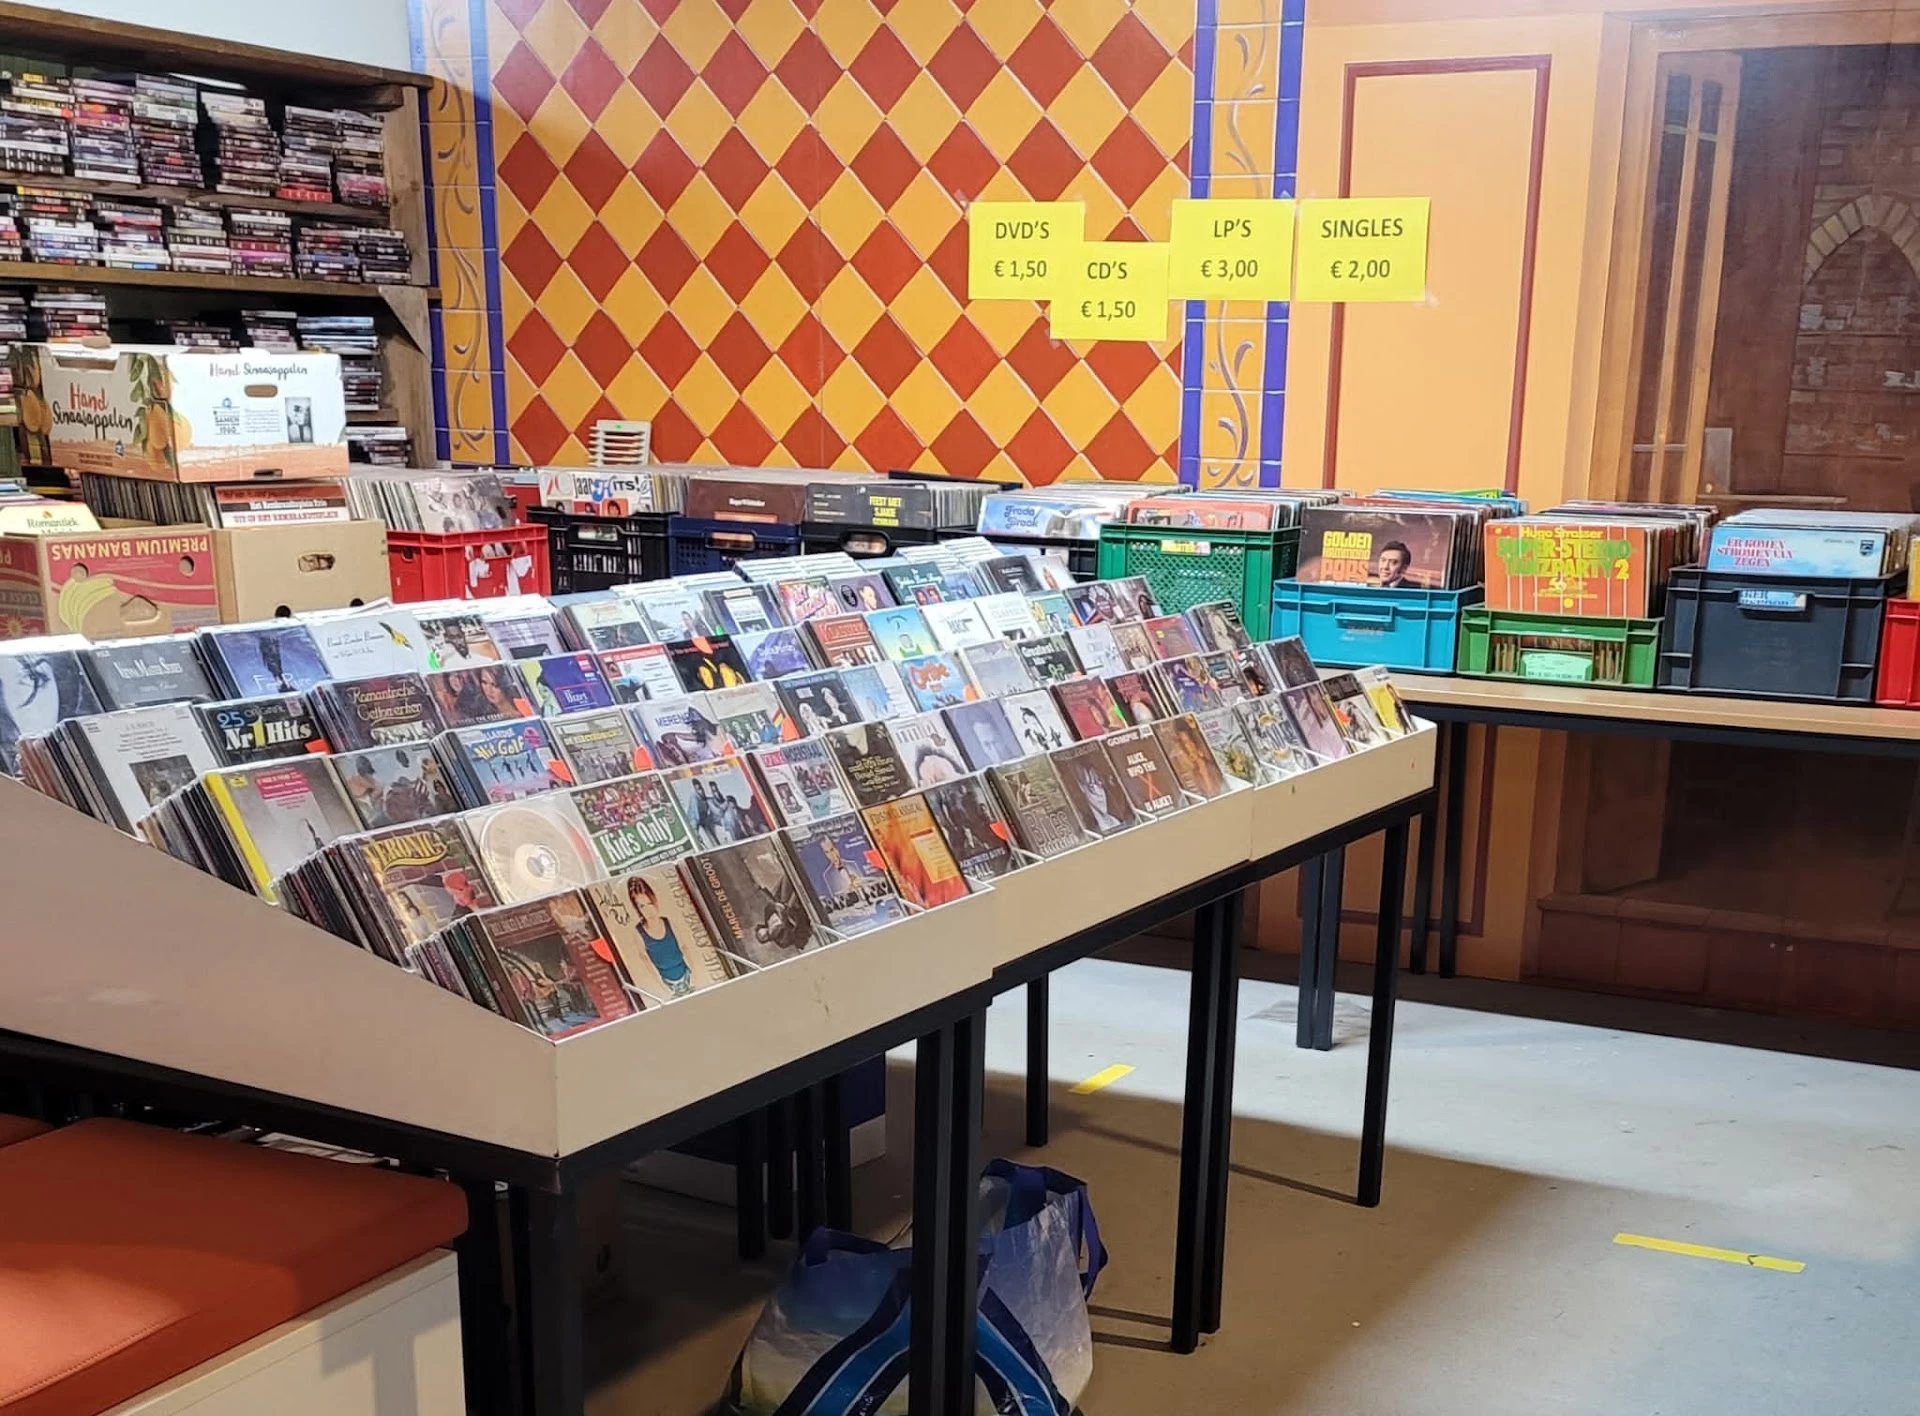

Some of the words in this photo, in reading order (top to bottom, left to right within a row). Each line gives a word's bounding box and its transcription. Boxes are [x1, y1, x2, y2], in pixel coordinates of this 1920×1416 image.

[995, 221, 1050, 241] DVD'S
[1213, 219, 1252, 238] LP'S
[1321, 217, 1403, 240] SINGLES
[994, 261, 1005, 278] €
[1010, 260, 1047, 279] 1,50
[1087, 262, 1128, 280] CD'S
[1201, 261, 1212, 277] €
[1217, 259, 1258, 279] 3,00
[1331, 261, 1342, 278] €
[1348, 259, 1391, 279] 2,00
[1081, 301, 1092, 318] €
[1097, 300, 1136, 319] 1,50
[69, 382, 108, 412] Hand
[136, 536, 208, 558] PREMIUM
[1322, 530, 1373, 550] GOLDEN
[51, 541, 132, 561] BANANAS
[1614, 559, 1630, 580] 2
[217, 711, 245, 729] 25
[265, 720, 312, 744] Hits
[498, 735, 525, 755] Golf
[600, 828, 641, 864] Kids
[700, 856, 721, 888] GROOT
[721, 902, 744, 940] MARCEL
